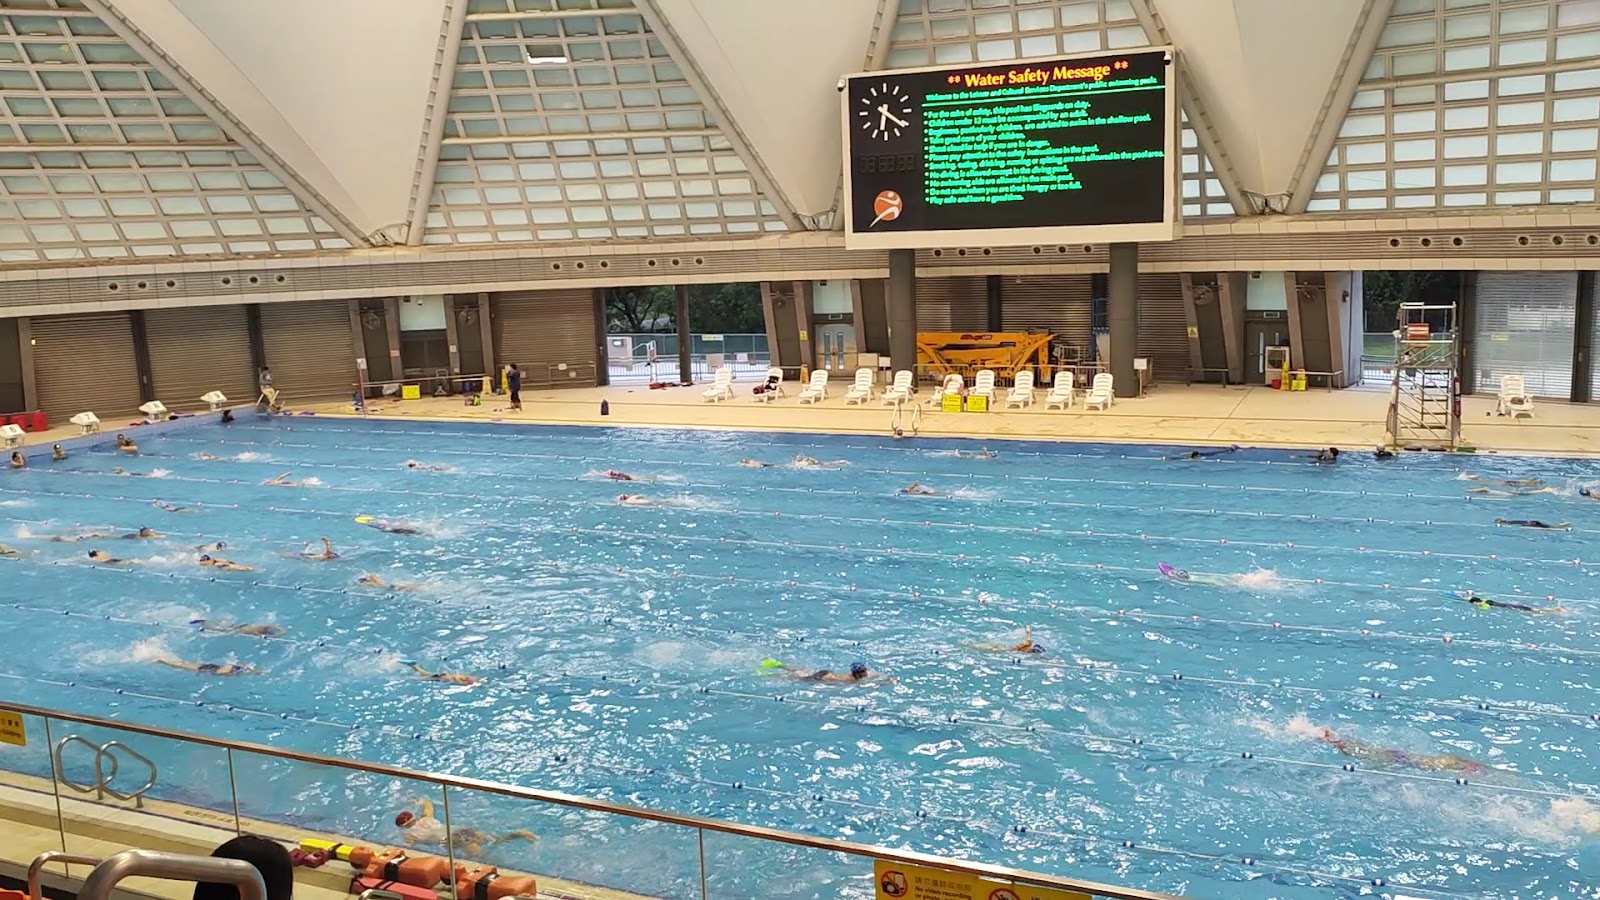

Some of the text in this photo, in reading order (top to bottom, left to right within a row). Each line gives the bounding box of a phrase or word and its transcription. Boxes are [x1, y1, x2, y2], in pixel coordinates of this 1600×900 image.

[965, 66, 1110, 87] Water Safety Message
[925, 887, 941, 895] video
[943, 891, 972, 900] recording
